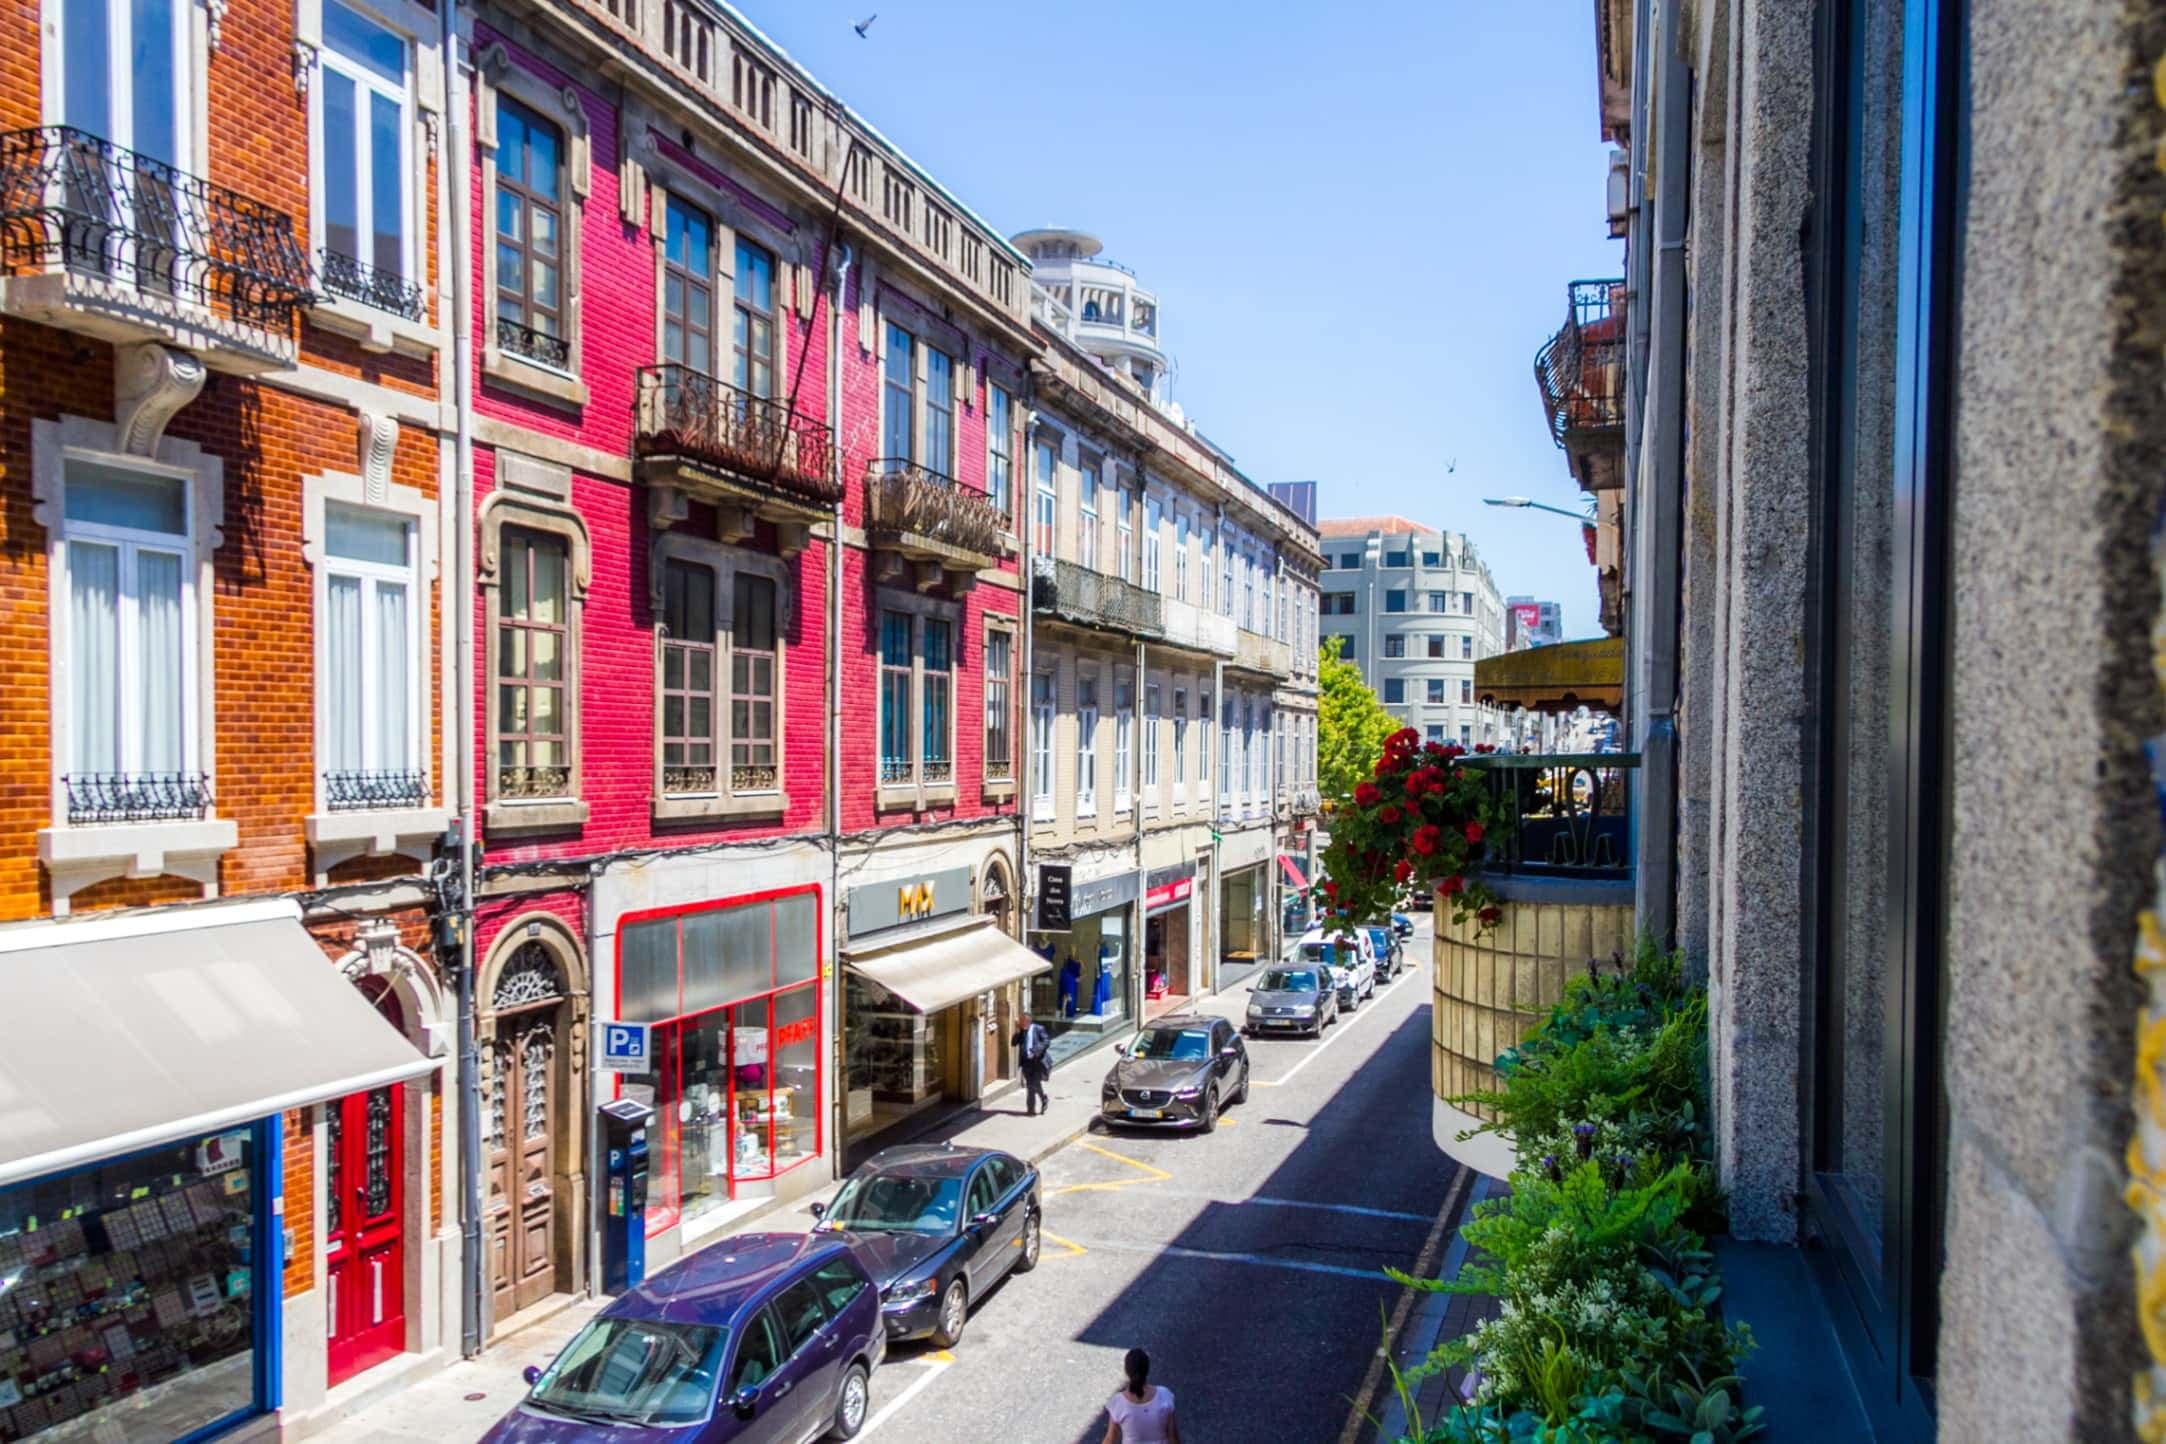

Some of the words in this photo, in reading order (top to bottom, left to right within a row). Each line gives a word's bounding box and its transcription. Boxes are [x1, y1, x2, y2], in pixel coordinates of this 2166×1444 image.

[899, 880, 936, 916] MAX
[609, 1028, 630, 1055] P
[777, 1017, 815, 1050] PFAFF
[610, 1150, 621, 1167] P
